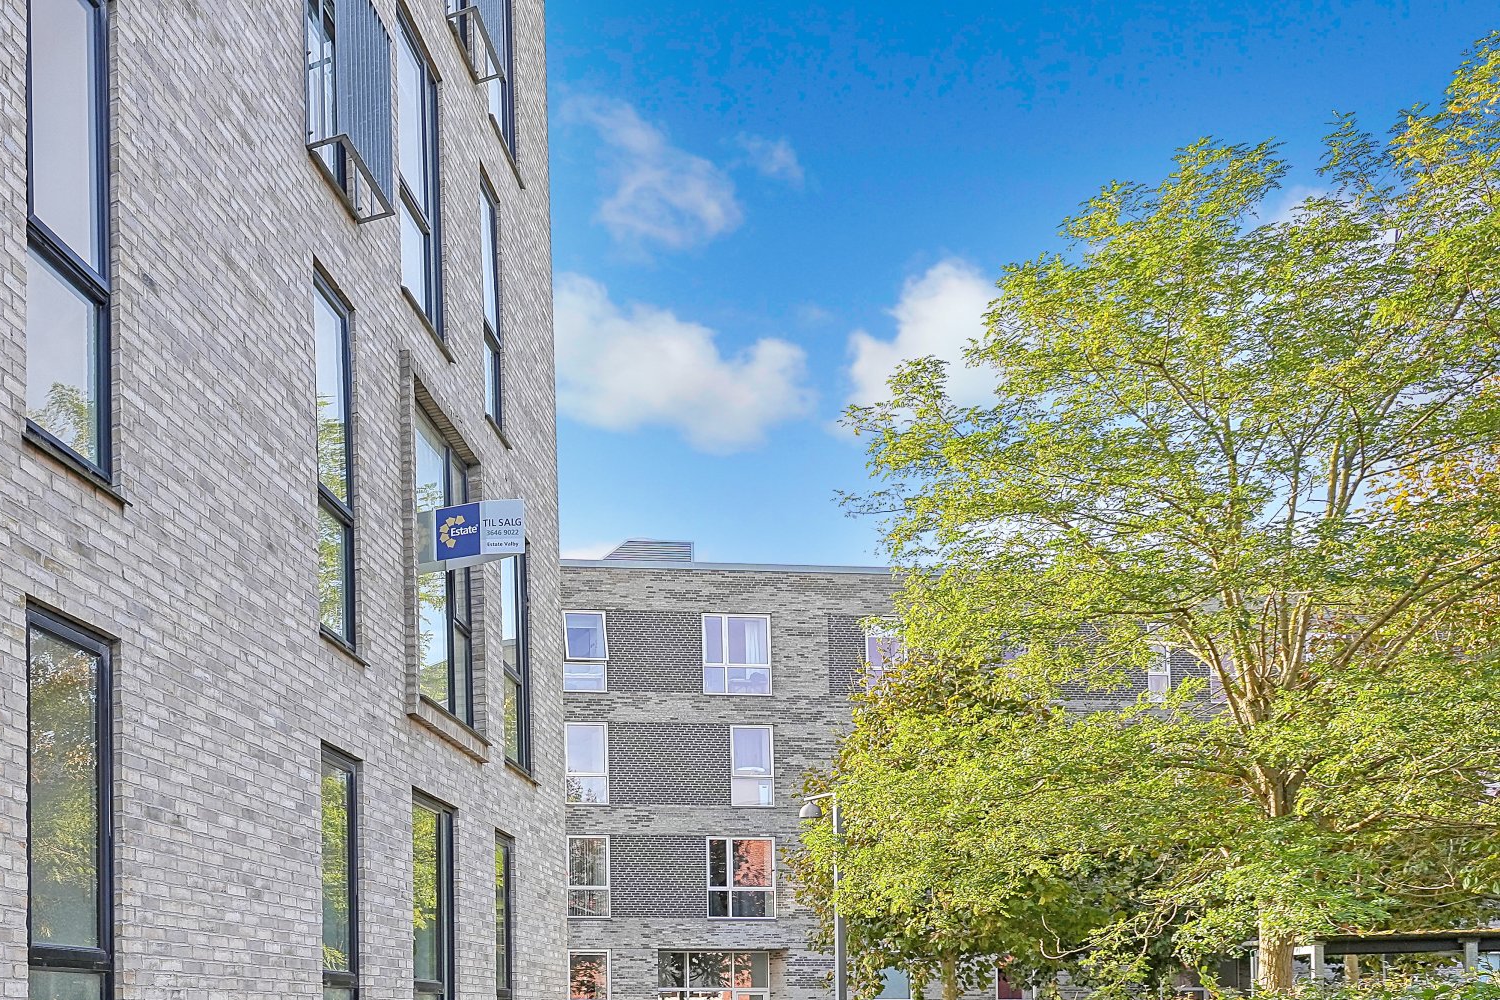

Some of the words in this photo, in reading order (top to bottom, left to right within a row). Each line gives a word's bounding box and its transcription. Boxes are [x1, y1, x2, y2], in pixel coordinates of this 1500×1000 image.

[482, 518, 496, 527] TIL
[498, 517, 522, 527] SALG
[450, 524, 478, 537] Estate
